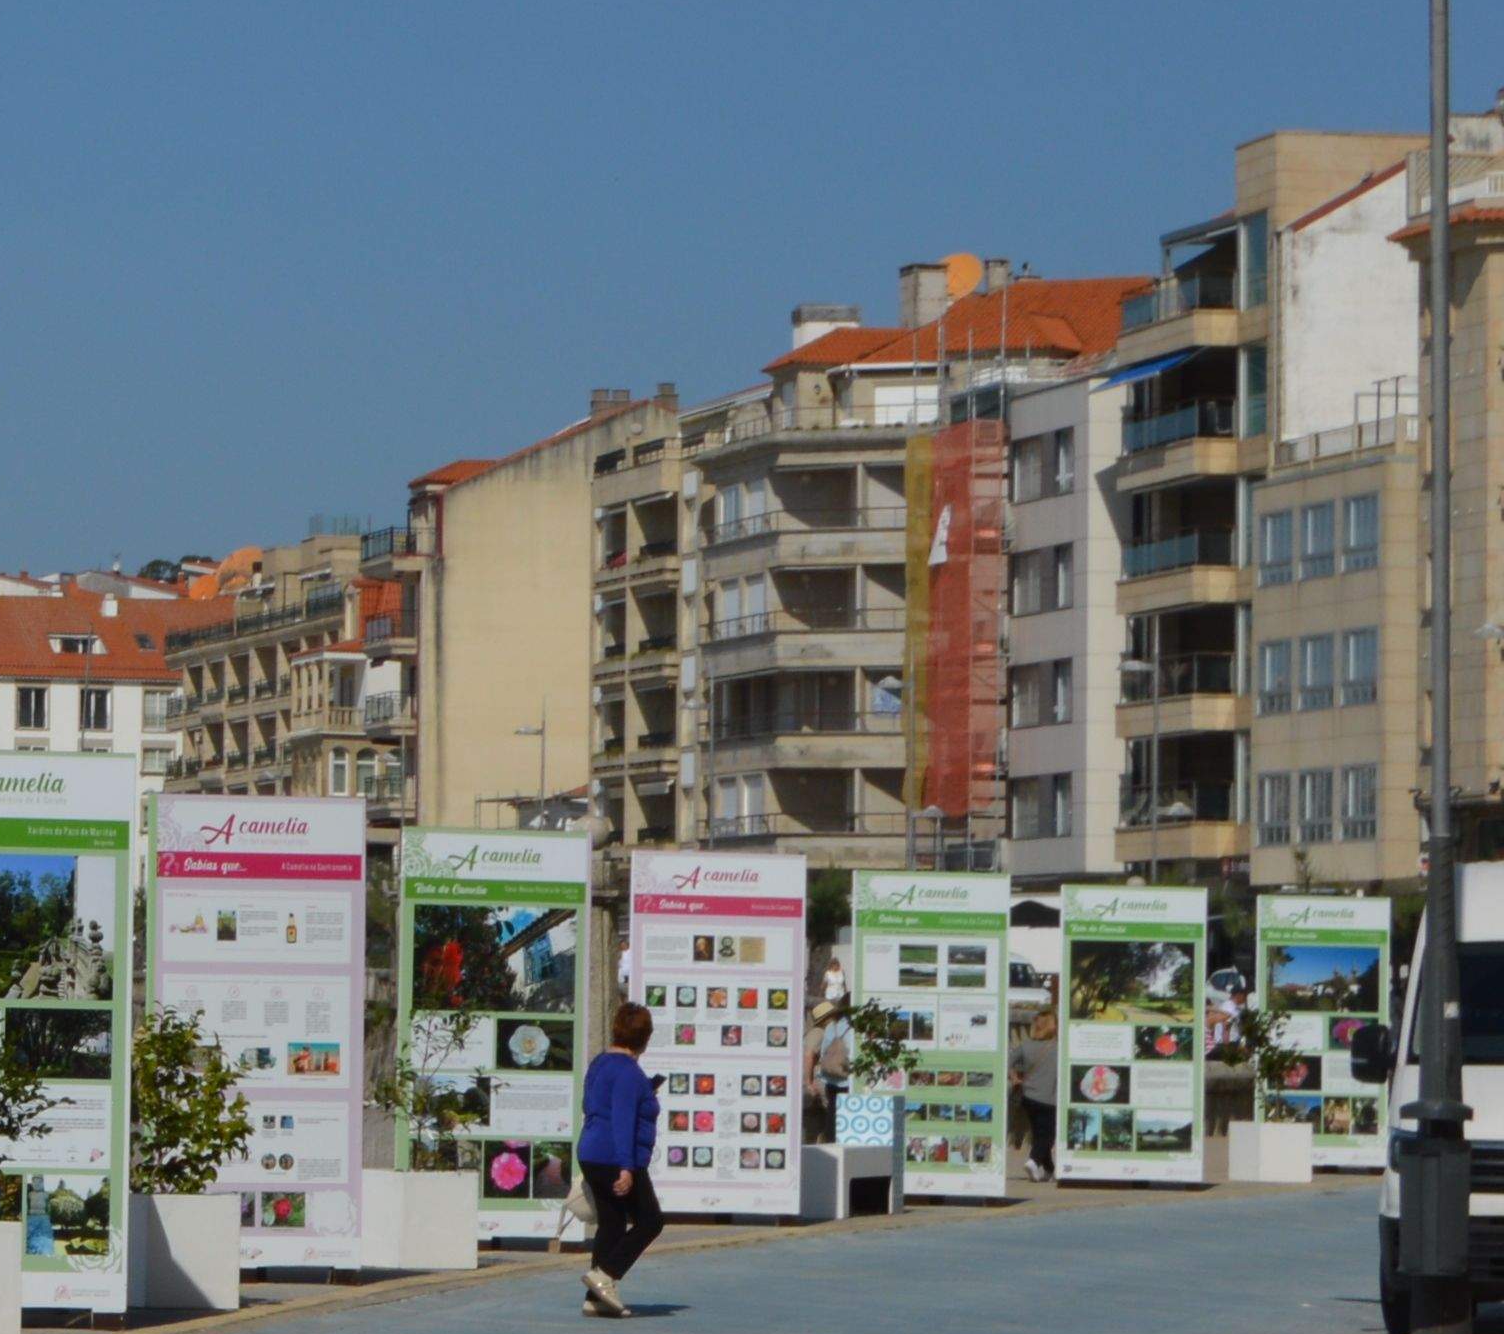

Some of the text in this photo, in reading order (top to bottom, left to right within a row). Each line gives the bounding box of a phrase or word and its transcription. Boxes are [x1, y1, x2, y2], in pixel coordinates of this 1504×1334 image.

[200, 813, 310, 845] A camelia
[448, 844, 542, 872] A camelia
[672, 865, 760, 890] A camelia
